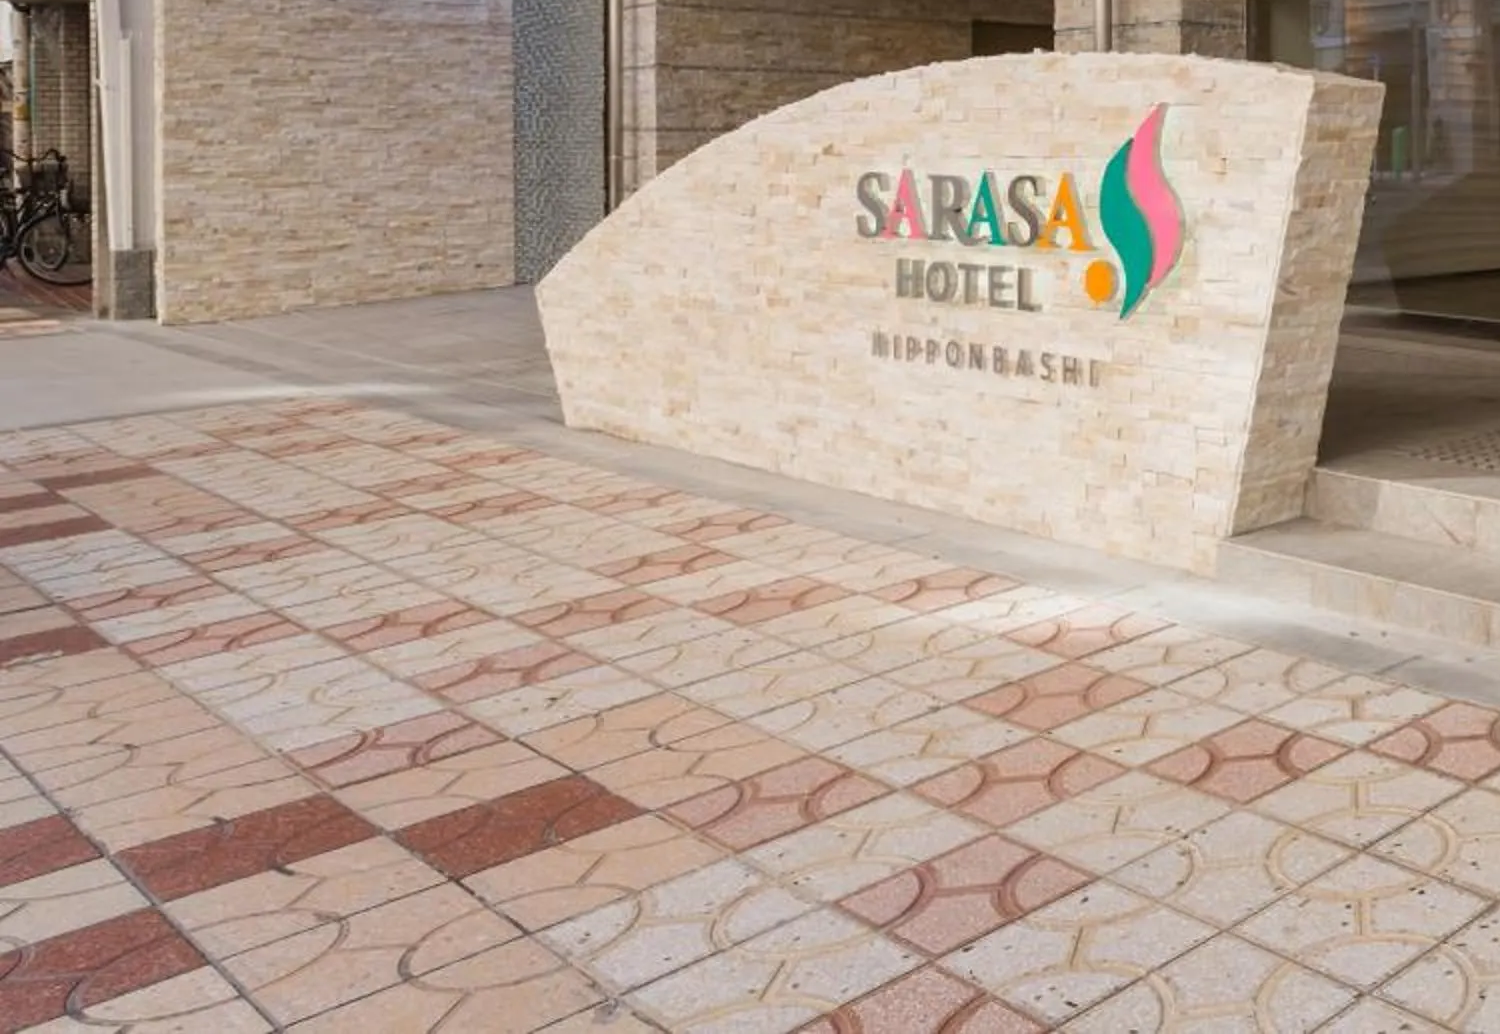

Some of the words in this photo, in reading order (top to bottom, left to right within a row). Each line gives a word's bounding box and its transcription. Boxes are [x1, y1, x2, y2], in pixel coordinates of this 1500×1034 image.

[856, 168, 1096, 252] SARASA
[895, 257, 1043, 312] HOTEL
[872, 330, 1102, 388] NIPPONBASHI
